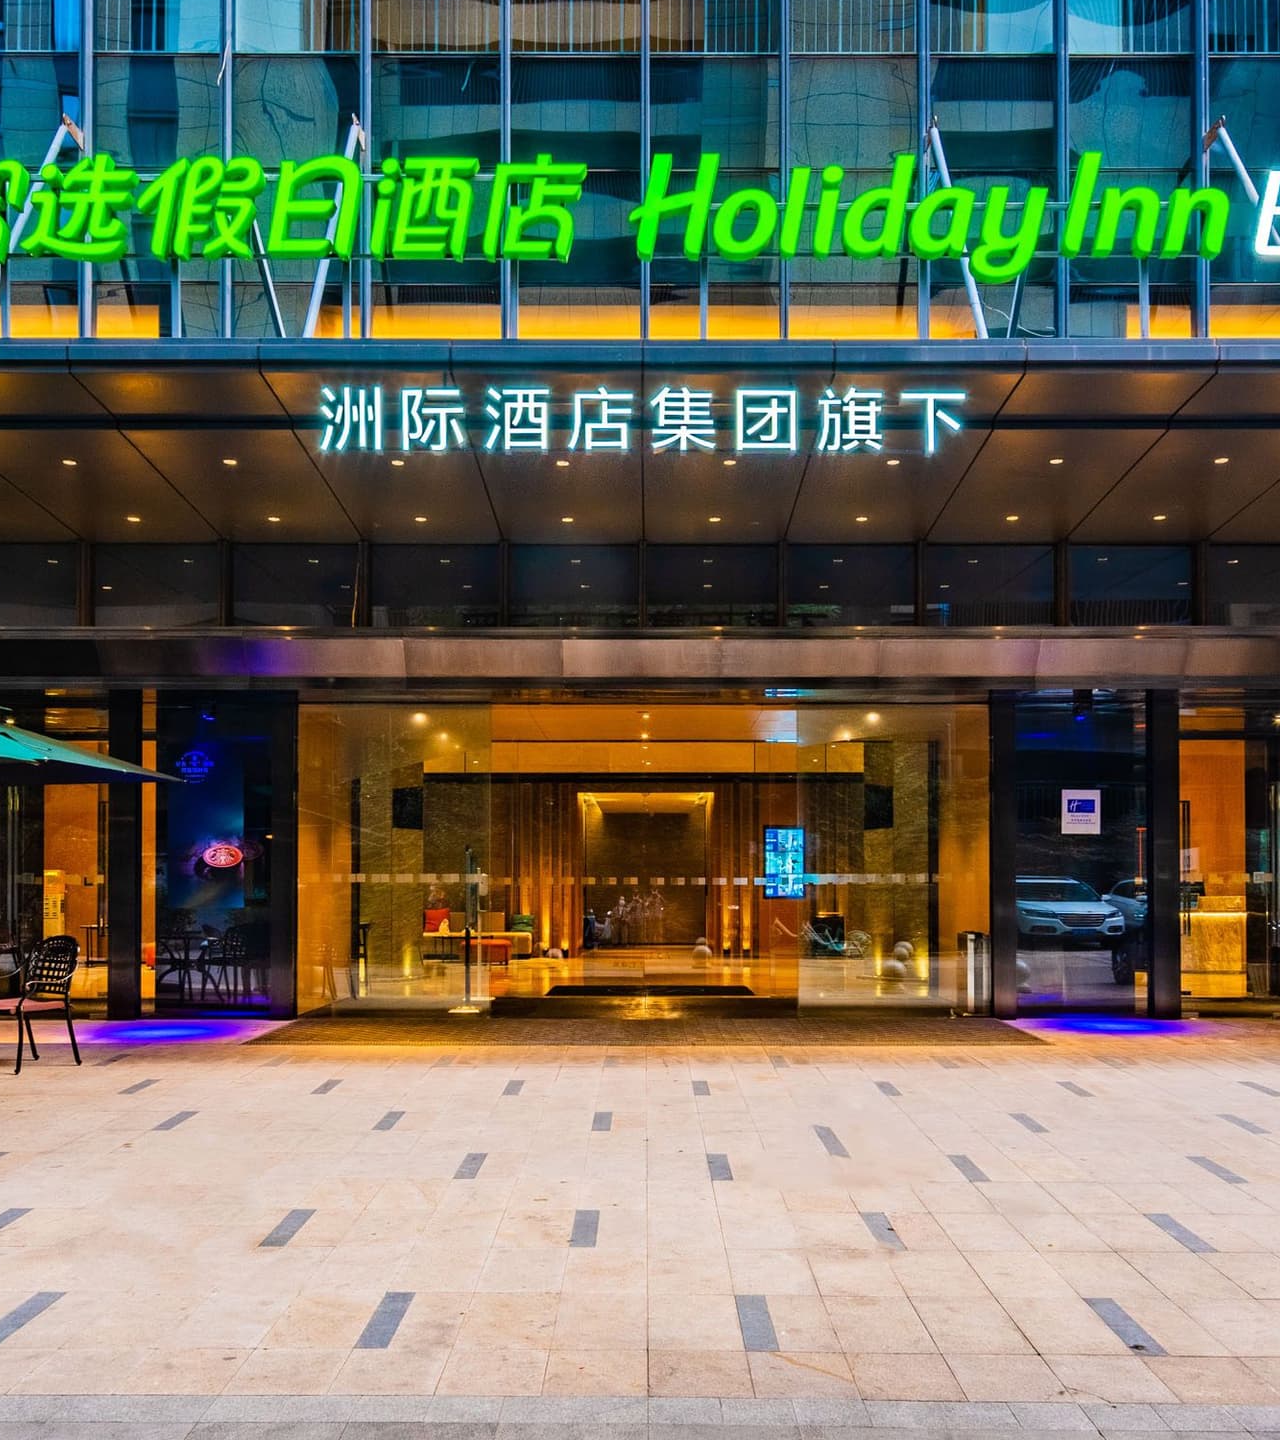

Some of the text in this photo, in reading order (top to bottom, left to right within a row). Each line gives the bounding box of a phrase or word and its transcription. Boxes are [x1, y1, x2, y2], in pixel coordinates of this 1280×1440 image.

[629, 151, 1050, 286] Holiday
[1064, 150, 1232, 261] Inn
[319, 385, 968, 455] 洲际酒店集团旗下
